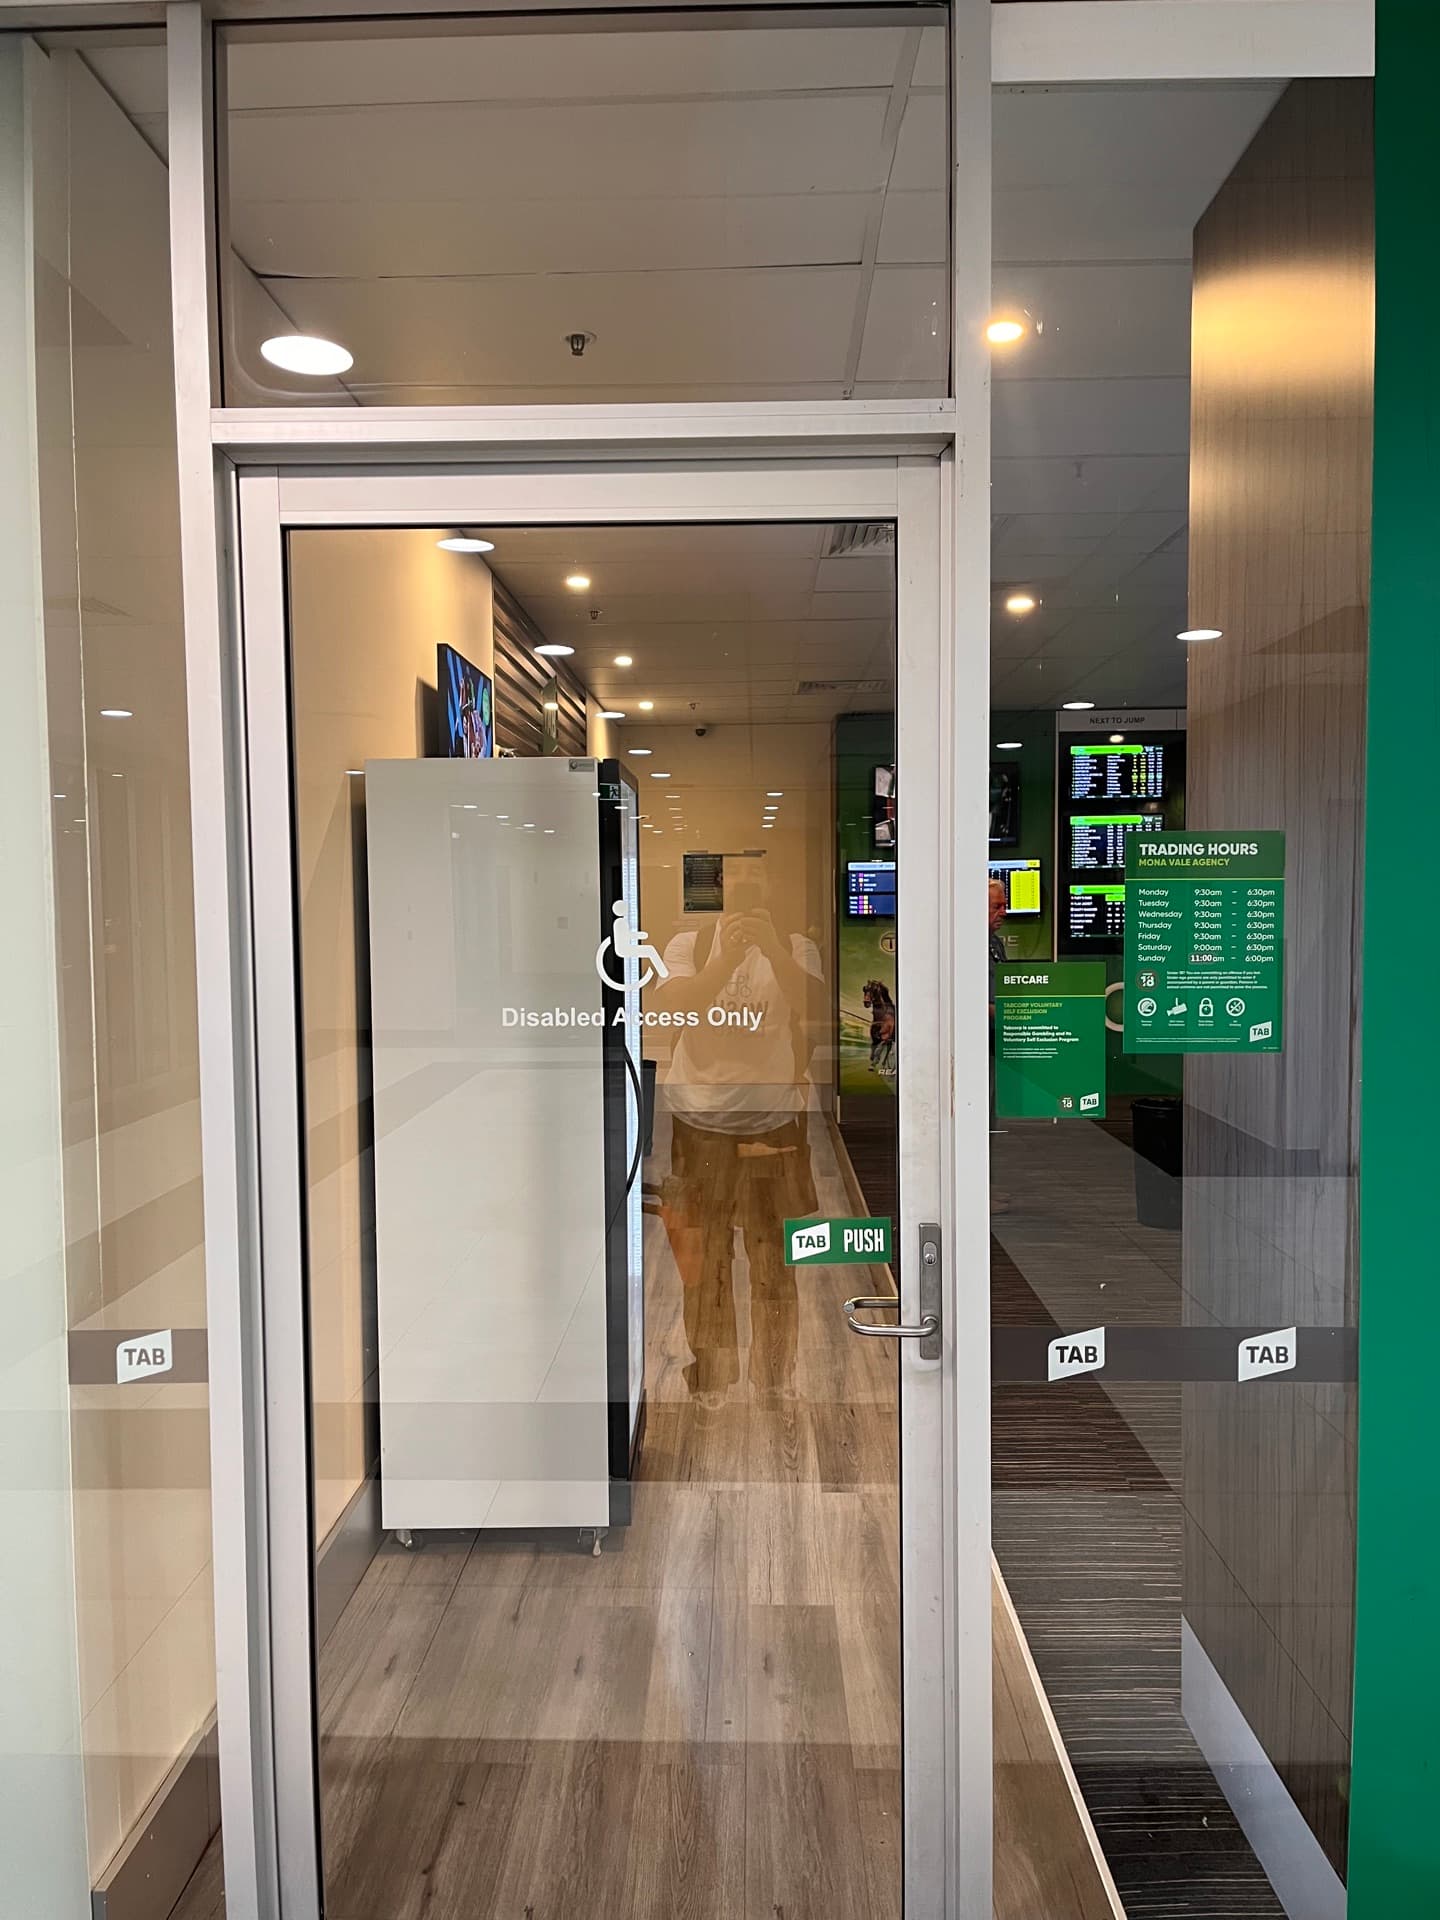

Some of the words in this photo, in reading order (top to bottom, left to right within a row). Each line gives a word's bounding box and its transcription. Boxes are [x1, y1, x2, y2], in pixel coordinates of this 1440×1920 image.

[1124, 716, 1145, 724] JUMP
[1139, 843, 1205, 855] TRADING
[1208, 843, 1258, 855] HOURS
[1192, 858, 1230, 866] AGENCY
[1004, 975, 1049, 985] BETCARE
[502, 1007, 606, 1027] Disabled
[612, 1007, 699, 1027] Access
[707, 1006, 763, 1032] Only
[1252, 1028, 1270, 1036] TAB
[1082, 1098, 1097, 1106] TAB
[796, 1235, 826, 1248] TAB
[842, 1228, 885, 1253] PUSH
[124, 1348, 165, 1366] TAB
[1056, 1346, 1098, 1363] TAB
[1246, 1346, 1289, 1364] TAB
